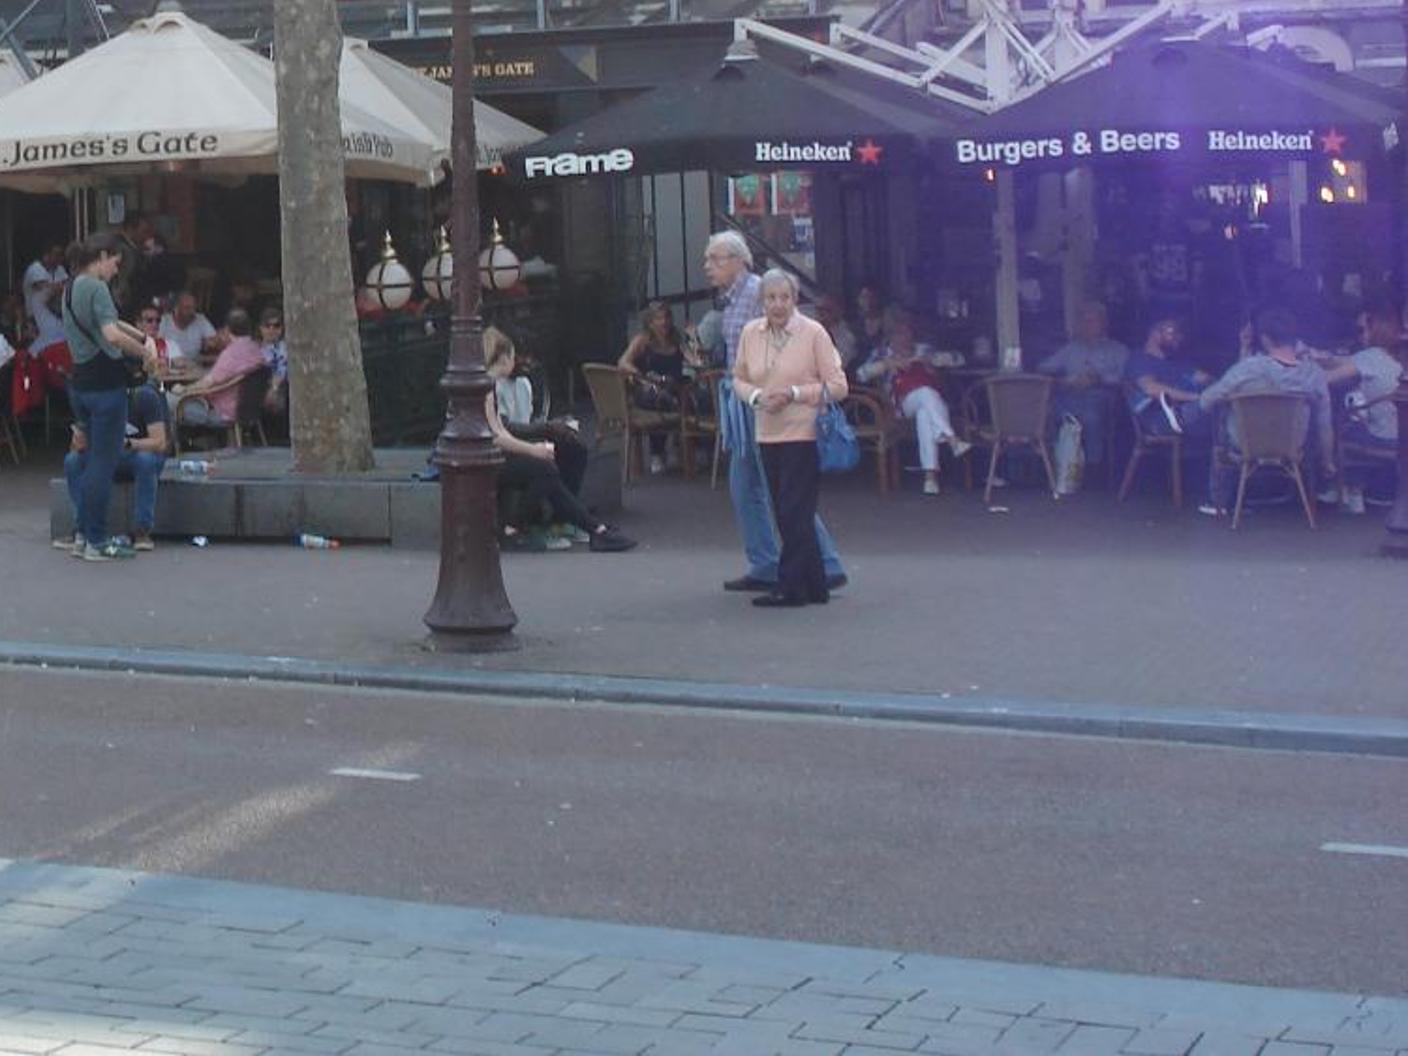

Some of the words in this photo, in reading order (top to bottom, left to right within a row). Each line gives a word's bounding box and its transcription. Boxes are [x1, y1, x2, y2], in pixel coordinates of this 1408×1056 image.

[494, 62, 535, 77] GATE
[136, 131, 219, 155] Gate
[755, 141, 852, 162] Heineken
[957, 135, 1064, 165] Burgers
[1072, 130, 1093, 155] &
[1099, 128, 1181, 153] Beers
[1208, 129, 1315, 151] Heineken
[525, 148, 635, 179] Frame
